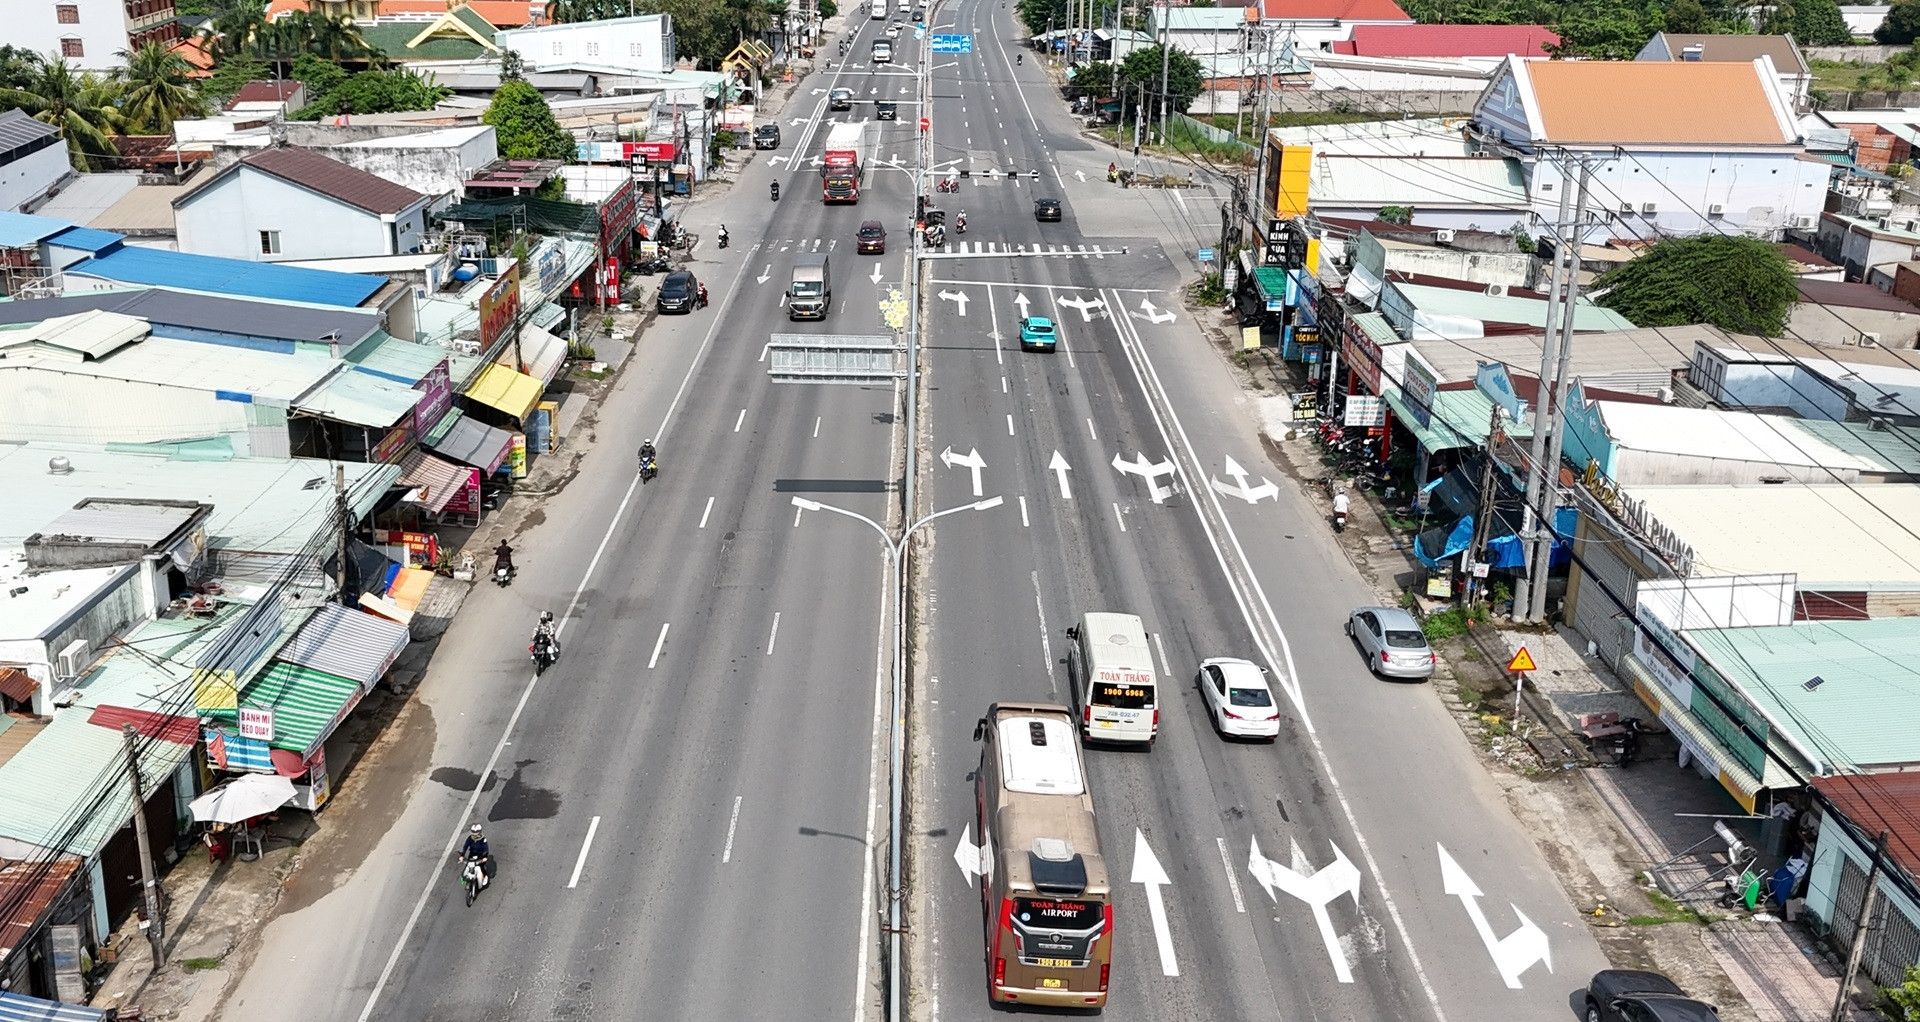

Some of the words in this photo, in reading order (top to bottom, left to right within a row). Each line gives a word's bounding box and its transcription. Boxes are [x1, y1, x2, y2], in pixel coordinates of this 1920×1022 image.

[1100, 670, 1121, 681] TOÀN
[1104, 687, 1122, 696] 1900
[1125, 689, 1144, 697] 6968
[242, 724, 254, 734] HEO
[255, 725, 269, 736] QUAY
[1041, 909, 1078, 918] AIRPORT
